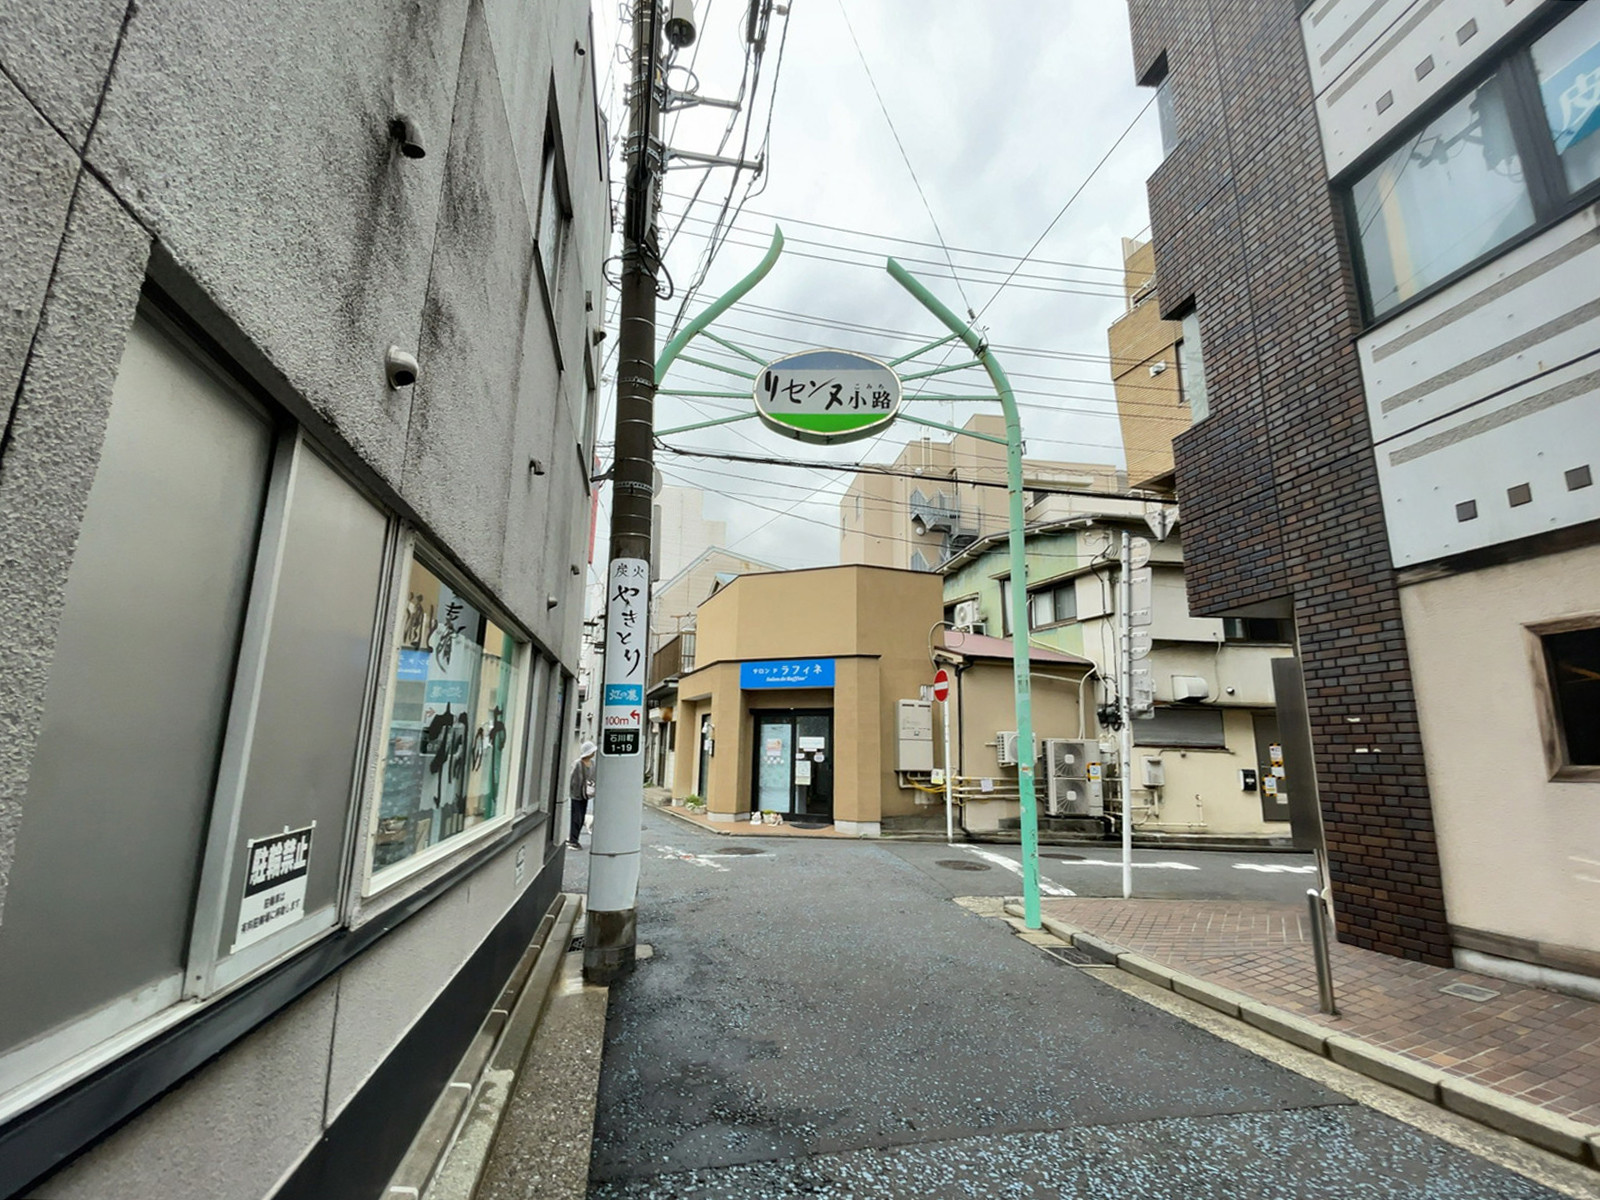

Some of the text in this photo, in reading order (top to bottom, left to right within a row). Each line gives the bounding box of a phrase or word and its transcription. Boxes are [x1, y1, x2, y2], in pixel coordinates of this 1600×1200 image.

[613, 562, 645, 579] 炭火
[612, 584, 641, 678] やきとり
[605, 716, 629, 725] 100m
[610, 734, 634, 742] 石川町
[249, 835, 308, 886] 駐輪禁止
